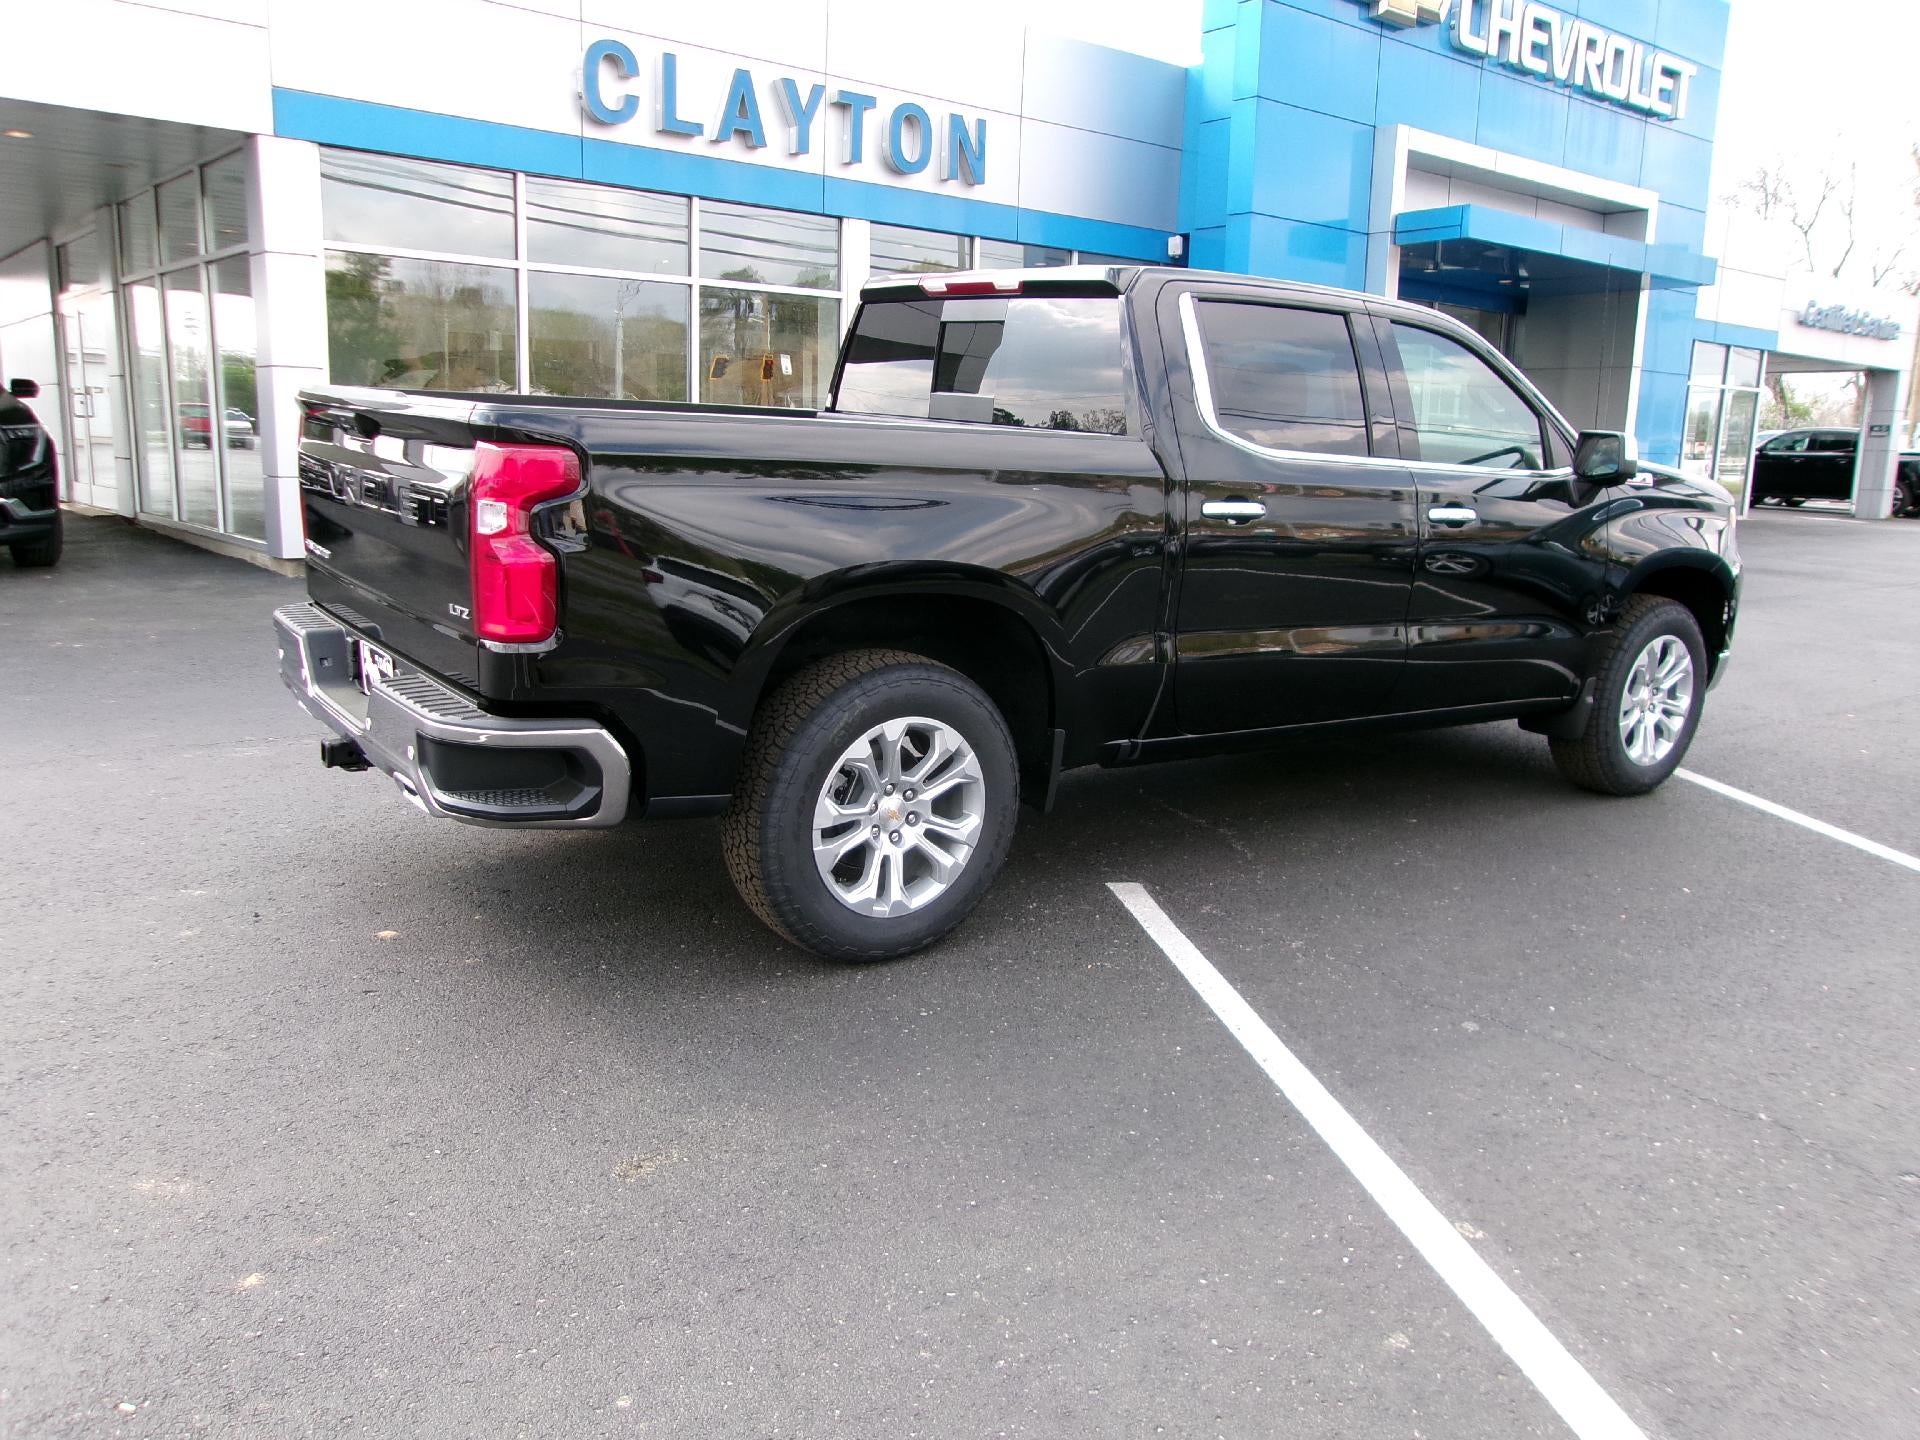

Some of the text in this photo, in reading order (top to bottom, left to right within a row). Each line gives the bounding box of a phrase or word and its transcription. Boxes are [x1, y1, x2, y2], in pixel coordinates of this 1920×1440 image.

[580, 38, 987, 186] CLAYTON
[1454, 0, 1697, 121] CHEVROLET
[448, 603, 472, 620] LTZ
